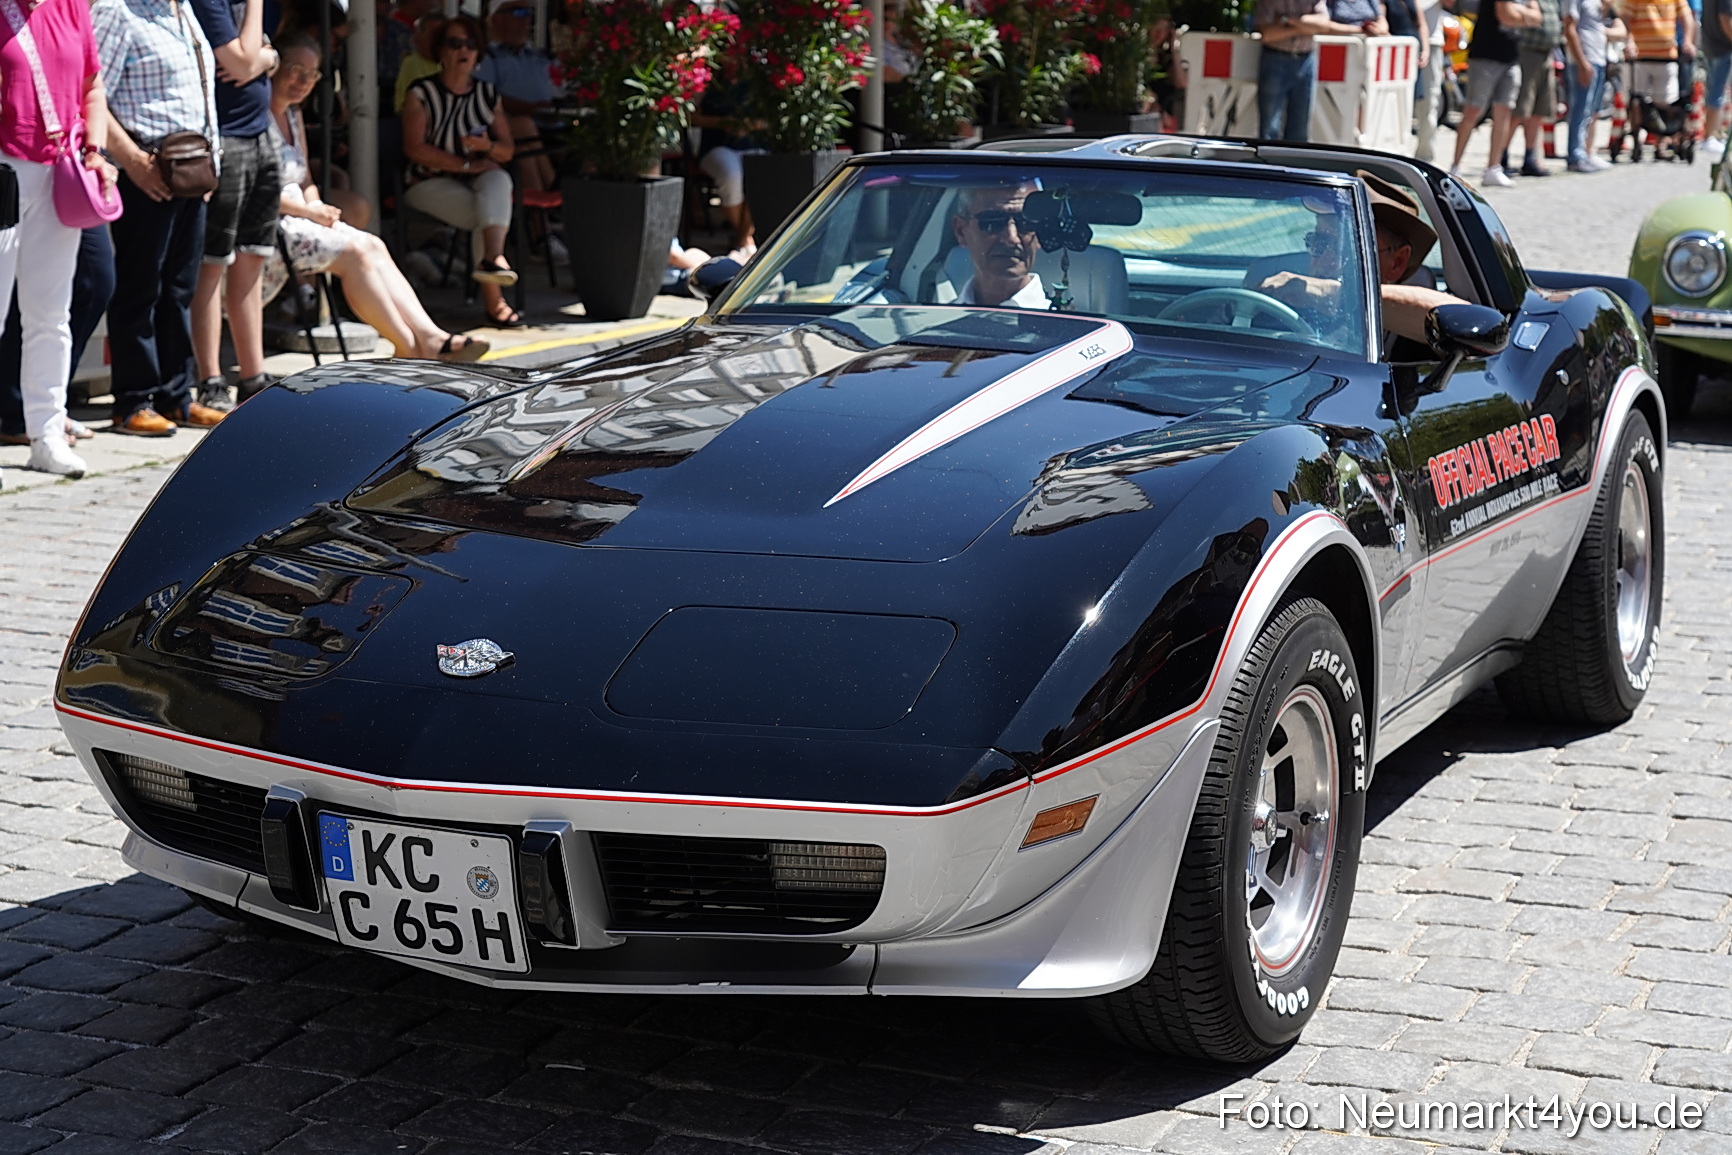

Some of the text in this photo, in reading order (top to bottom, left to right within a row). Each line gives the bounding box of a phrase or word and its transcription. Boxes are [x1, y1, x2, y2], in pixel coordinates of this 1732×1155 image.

[1428, 413, 1561, 509] OFFICIAL PACE CAR
[1450, 472, 1559, 538] 62nd ANNUAL INDIANAPOLIS 500 MILE RACE
[1307, 648, 1356, 702] EAGLE
[332, 856, 345, 873] D
[361, 829, 440, 893] KC
[339, 890, 516, 964] C 65H
